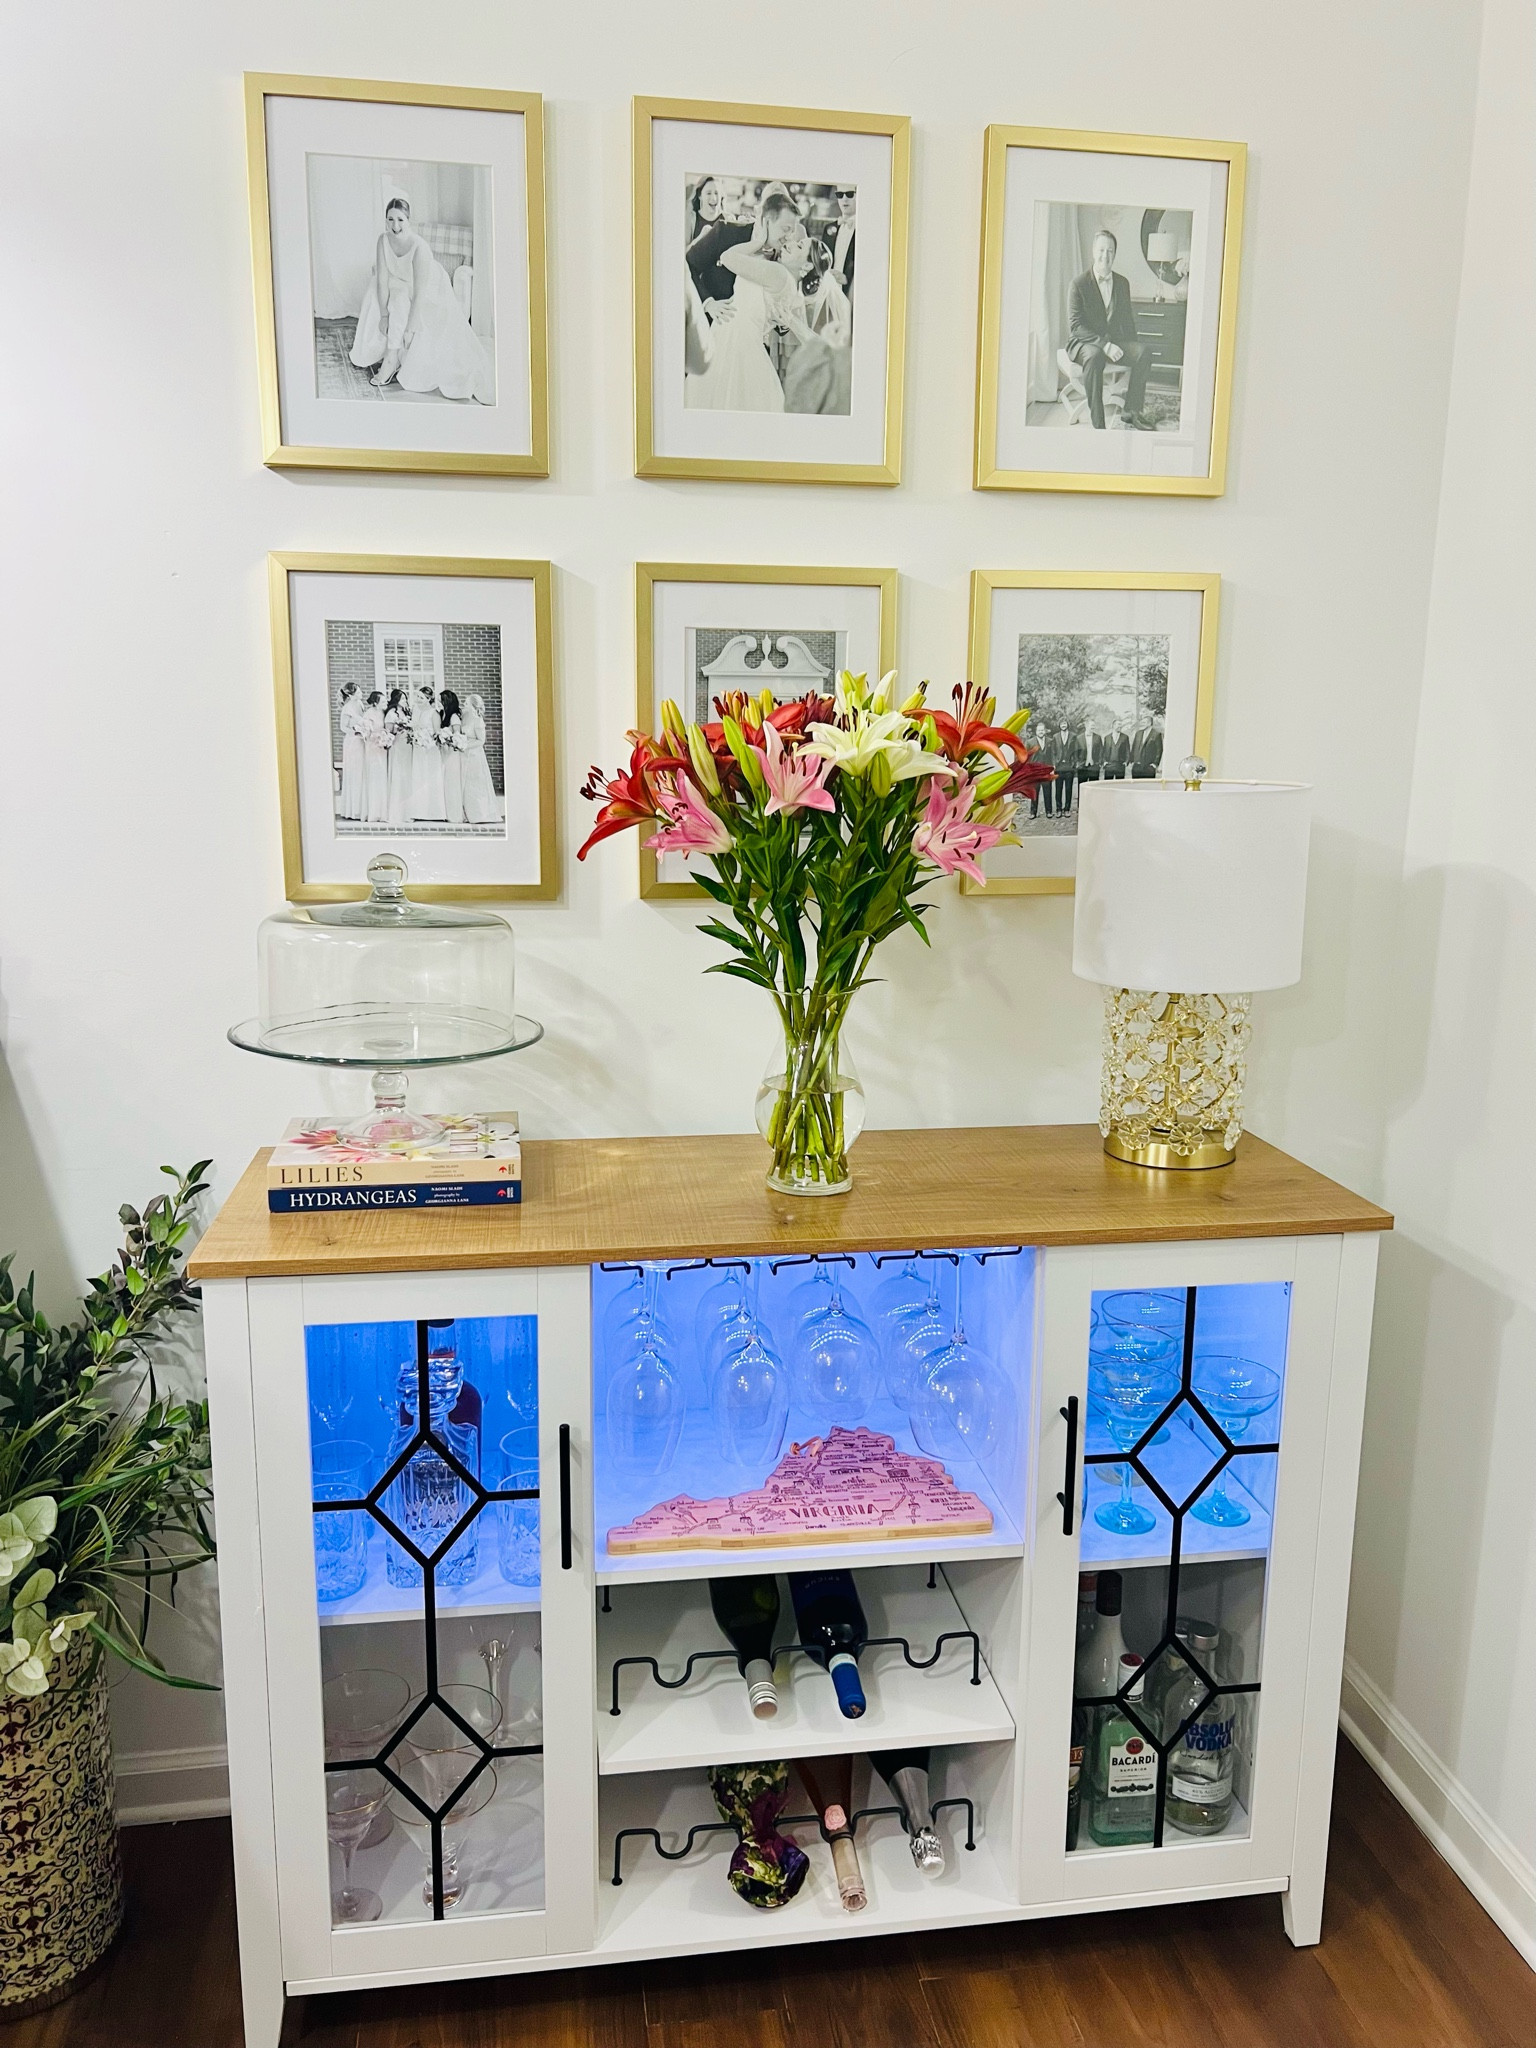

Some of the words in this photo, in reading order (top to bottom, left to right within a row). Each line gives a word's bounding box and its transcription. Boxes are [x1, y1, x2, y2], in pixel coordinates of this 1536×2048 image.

[281, 1166, 363, 1184] LILIES
[290, 1189, 417, 1207] HYDRANGEAS
[789, 1504, 880, 1518] VIRGINIA
[1185, 1732, 1232, 1751] VODKA
[1111, 1752, 1156, 1766] BACARDÍ
